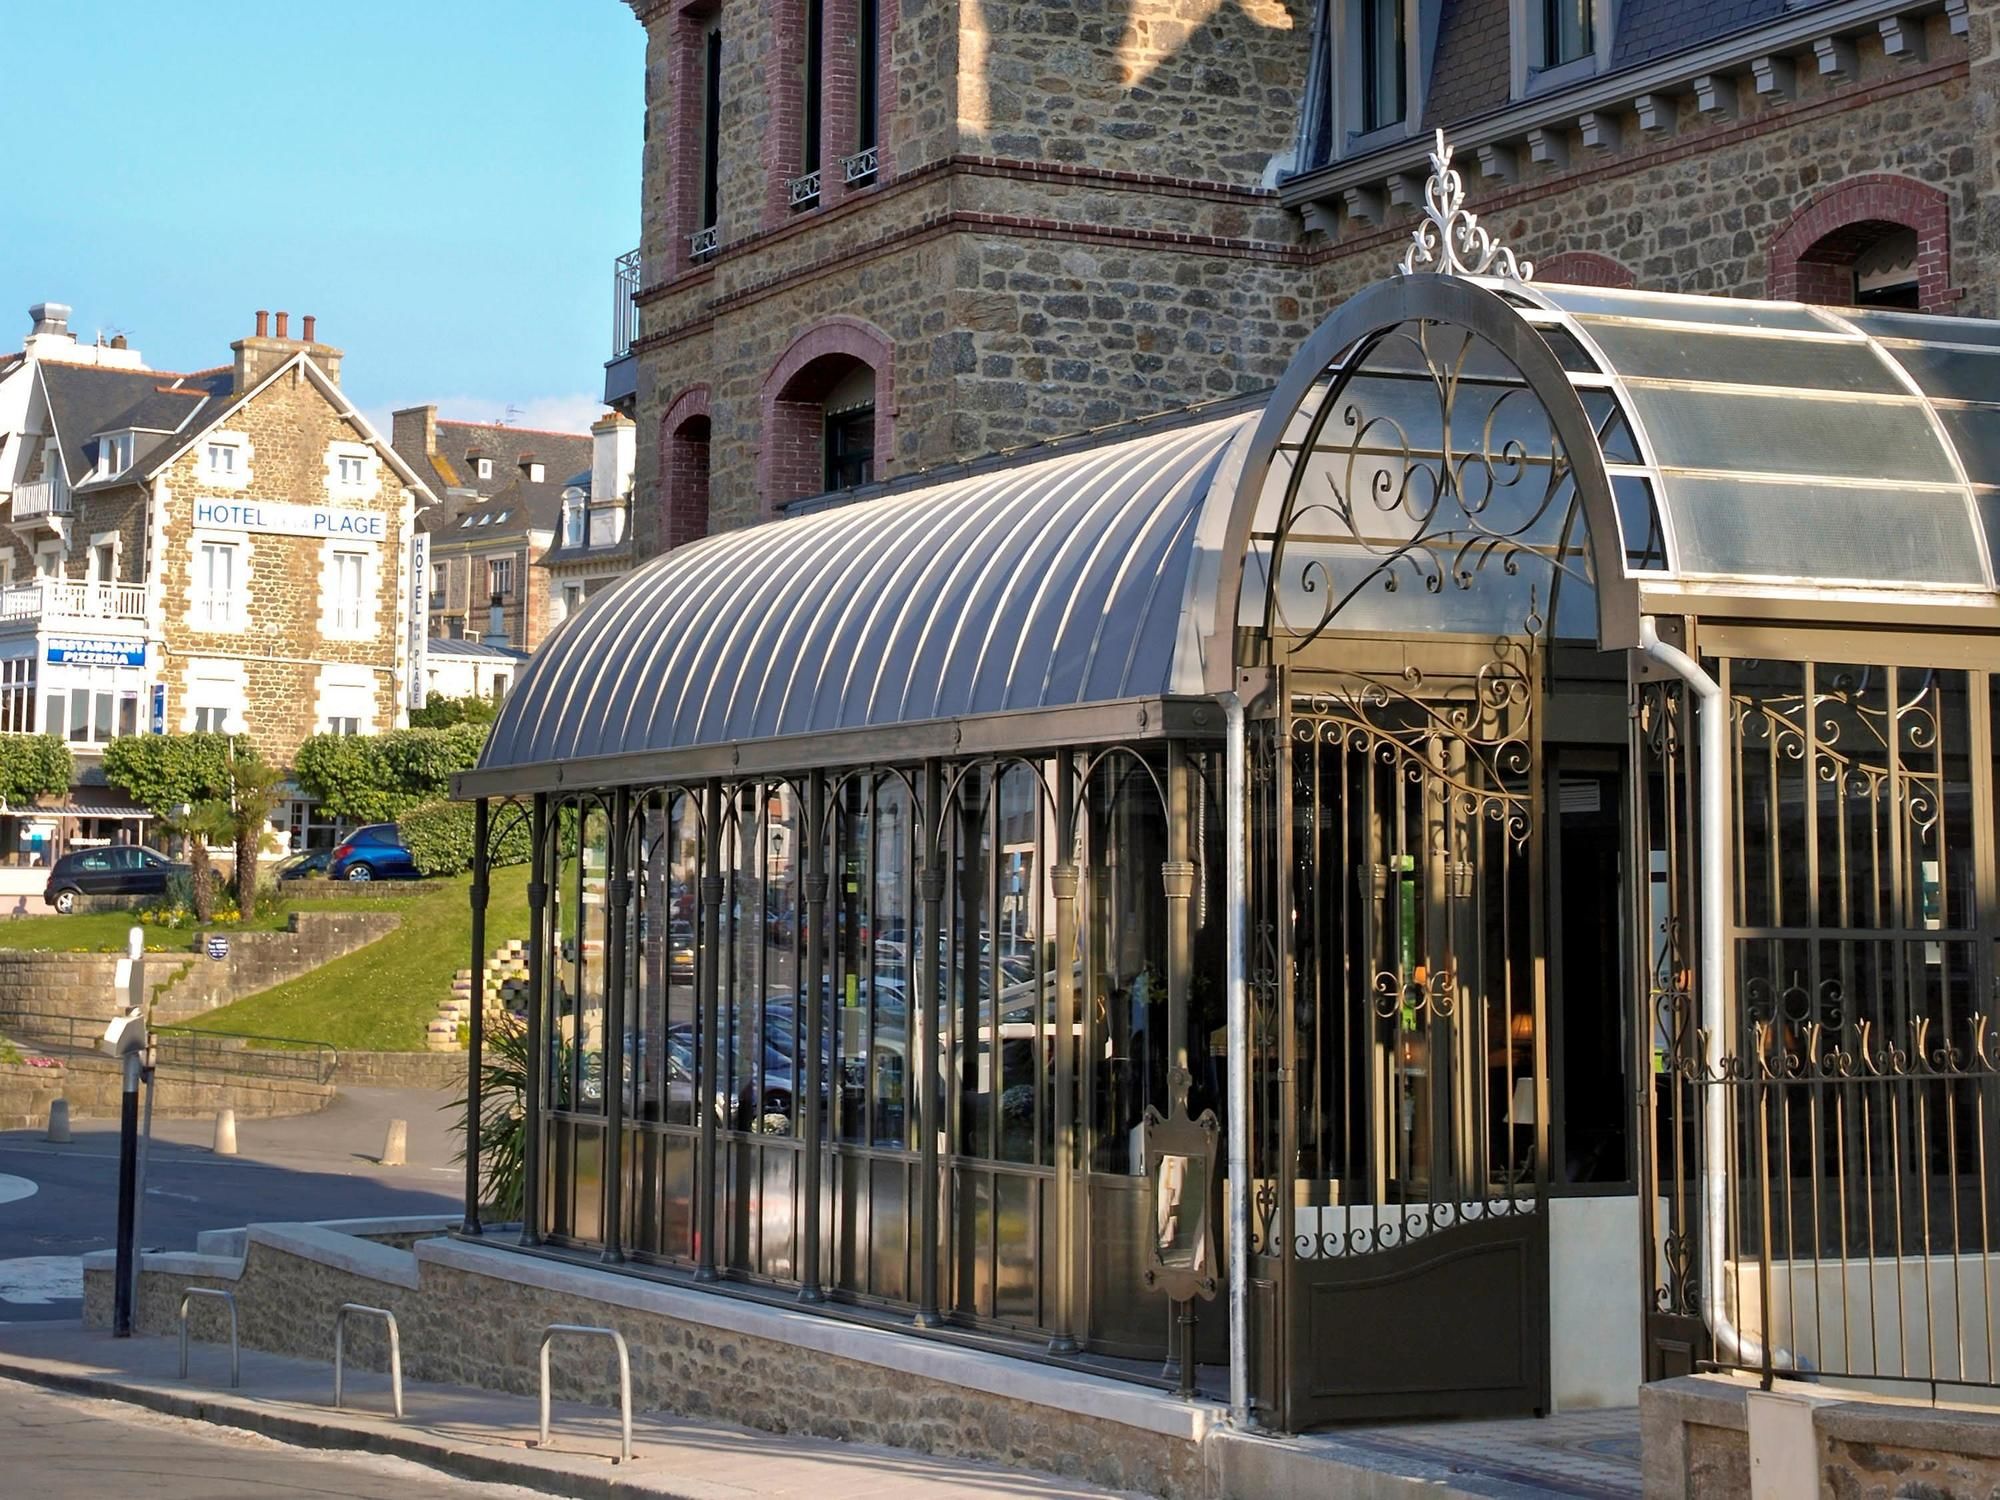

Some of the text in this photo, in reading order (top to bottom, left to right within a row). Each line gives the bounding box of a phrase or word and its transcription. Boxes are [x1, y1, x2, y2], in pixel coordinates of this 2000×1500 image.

[198, 504, 267, 526] HOTEL
[314, 513, 382, 535] PLAGE
[415, 538, 424, 615] HOTEL
[62, 651, 129, 665] PIZZERIA
